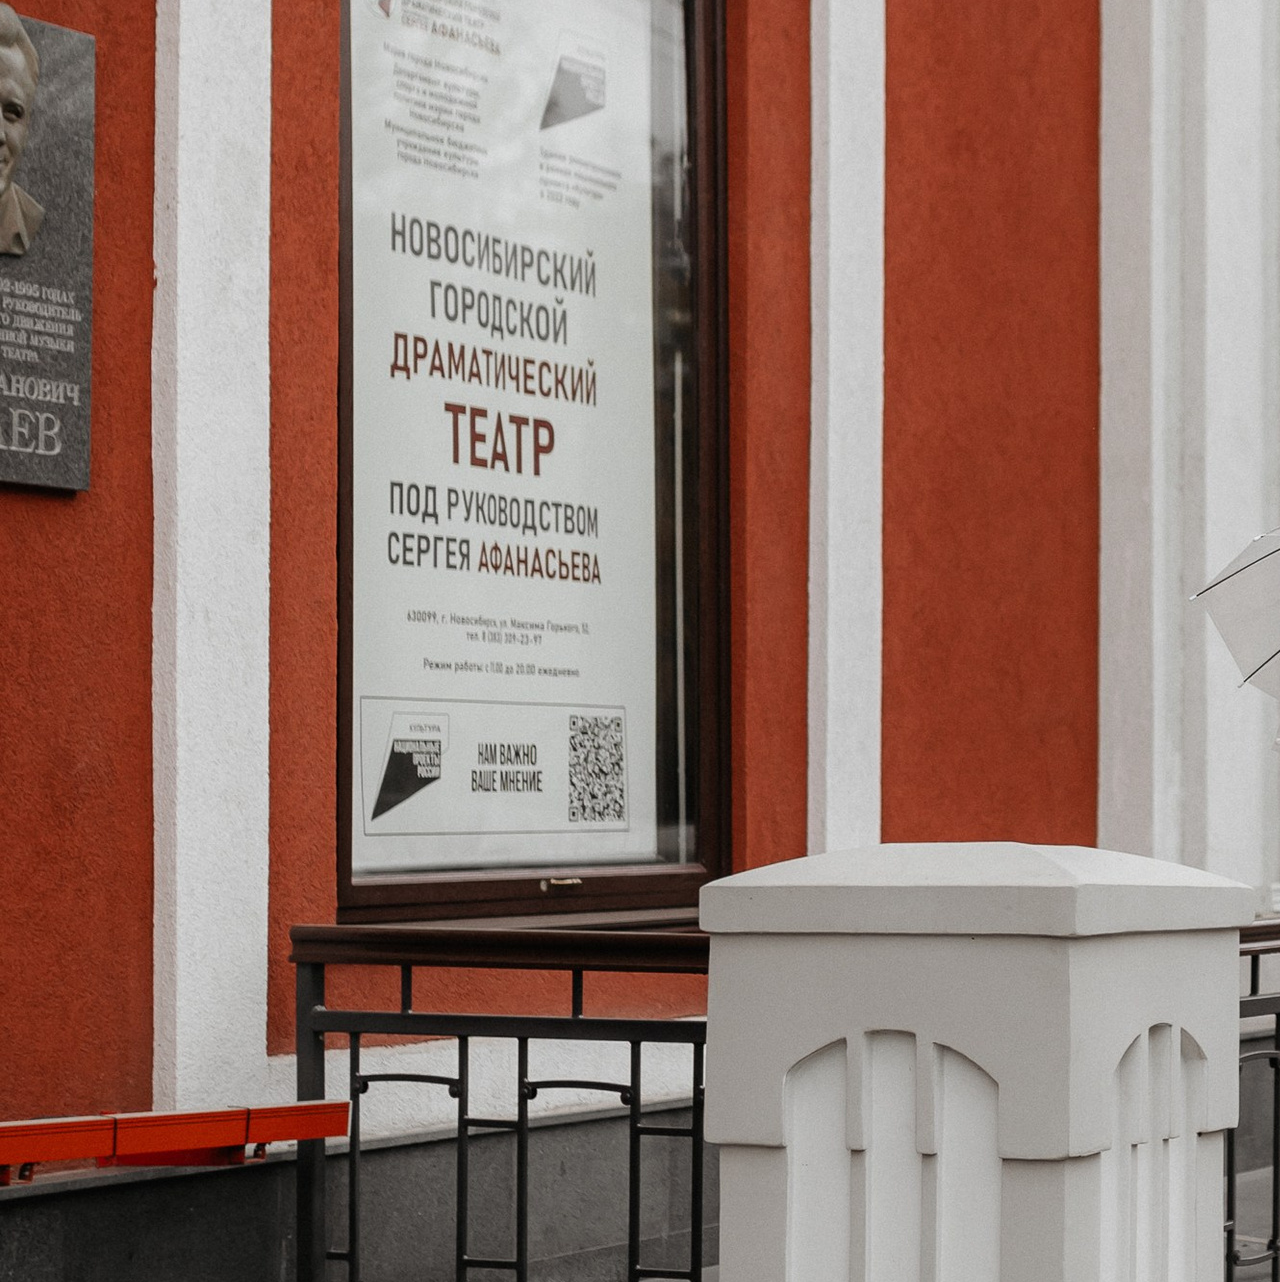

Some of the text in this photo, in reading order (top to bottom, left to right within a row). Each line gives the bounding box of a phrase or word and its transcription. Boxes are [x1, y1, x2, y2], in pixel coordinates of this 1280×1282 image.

[390, 212, 597, 298] НОВОСИБИРСКИЙ
[430, 280, 568, 345] ГОРОДСКОЙ
[390, 332, 598, 407] ДРАМАТИЧЕСКИЙ
[444, 402, 556, 477] ТЕАТР
[389, 481, 599, 539] ПОД РУКОВОДСТВОМ
[387, 531, 602, 585] СЕРГЕЯ АФАНАСЬЕВА
[423, 657, 452, 671] Режим
[455, 660, 483, 674] работы
[471, 769, 544, 793] ВАШЕ МНЕНИЕ
[477, 742, 537, 767] НАМ ВАЖНО
